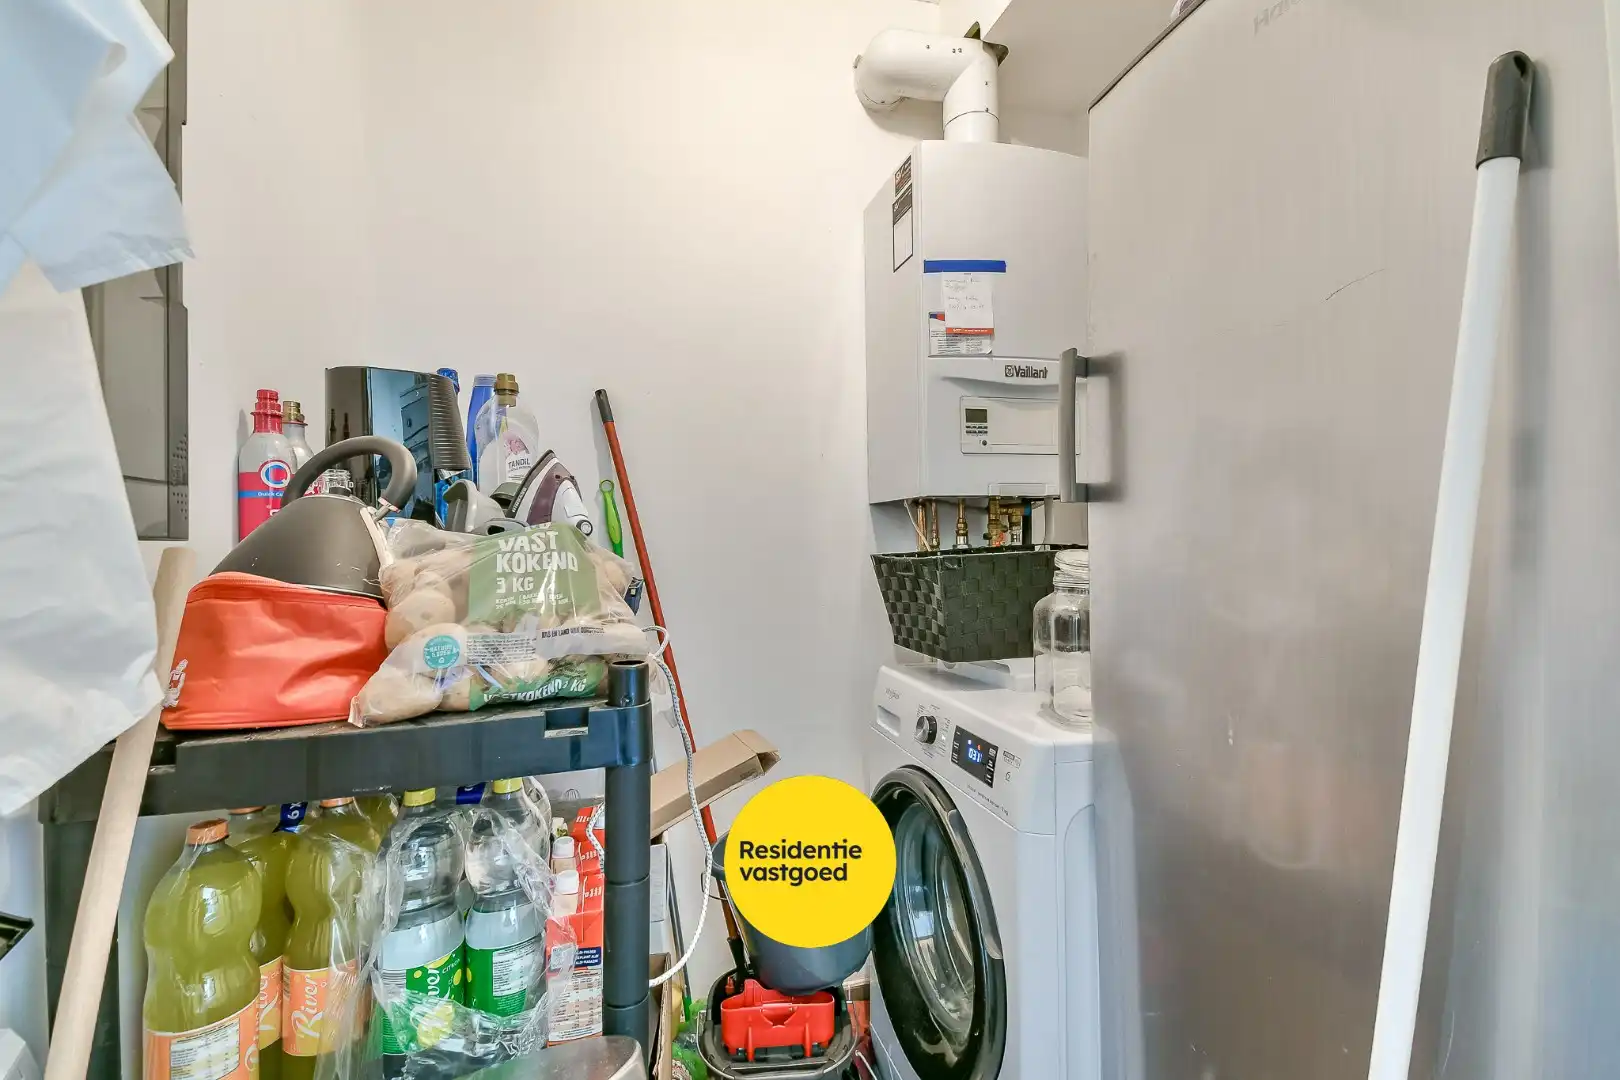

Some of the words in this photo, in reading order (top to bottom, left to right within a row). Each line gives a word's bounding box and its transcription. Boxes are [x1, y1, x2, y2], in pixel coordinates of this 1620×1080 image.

[1013, 365, 1048, 379] Vaillant
[498, 531, 559, 553] VAST
[496, 551, 579, 574] KOKEND
[513, 576, 534, 591] KG
[570, 678, 587, 693] KG
[290, 974, 324, 1039] River
